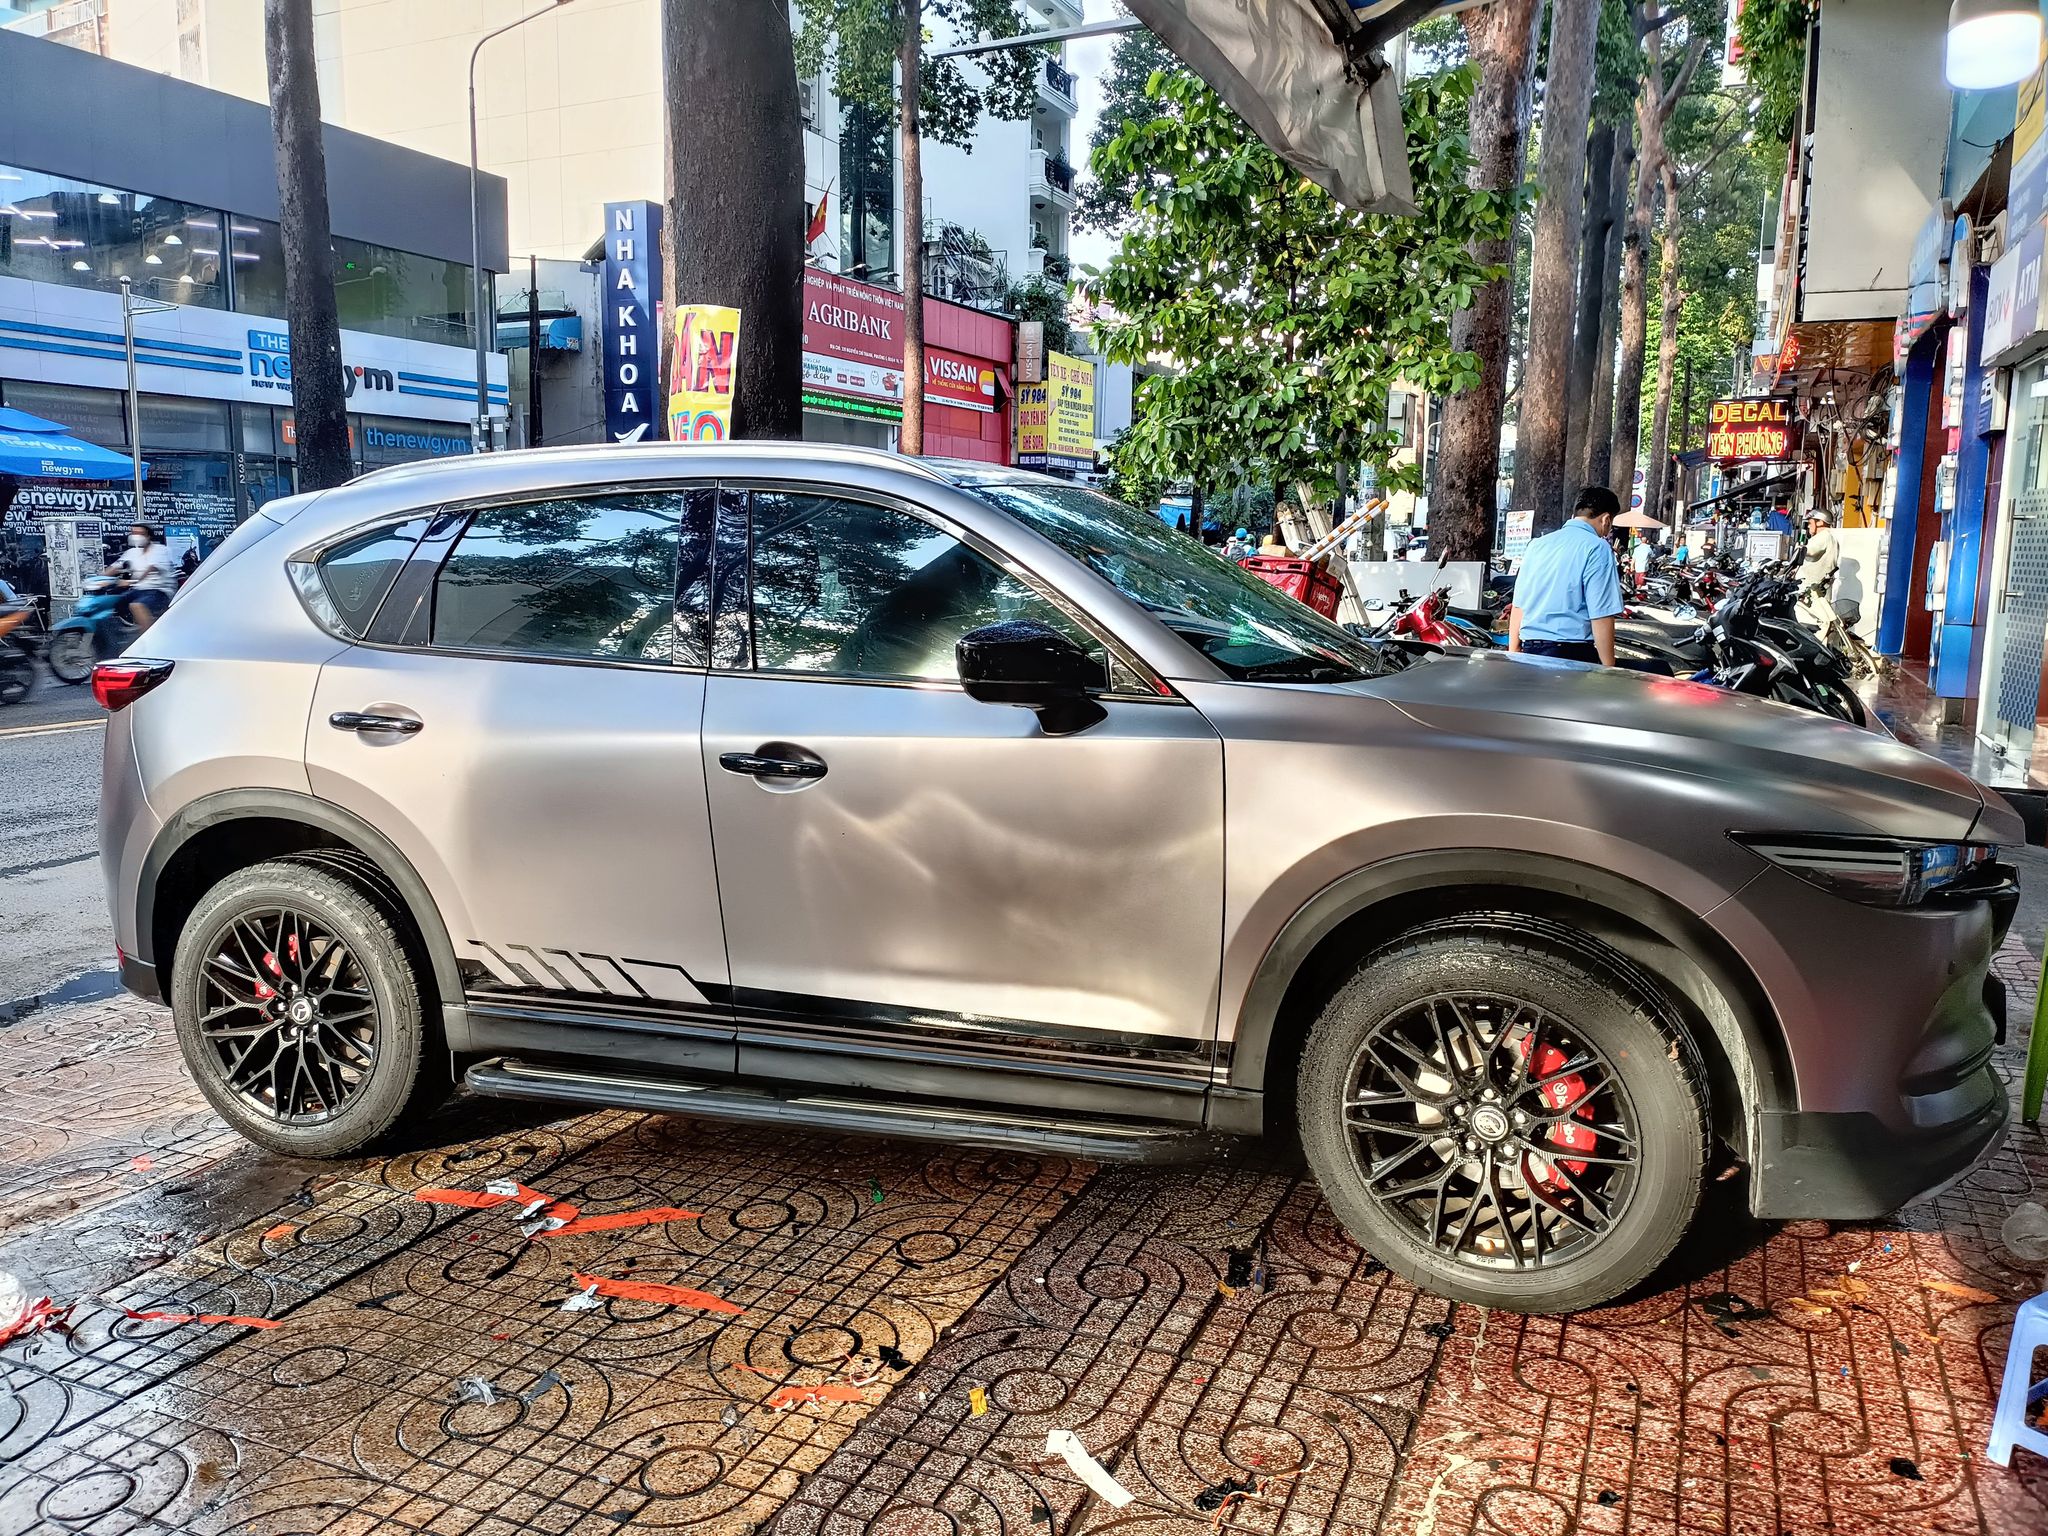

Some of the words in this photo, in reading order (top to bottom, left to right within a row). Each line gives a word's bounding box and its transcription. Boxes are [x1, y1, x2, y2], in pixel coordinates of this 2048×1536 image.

[616, 209, 636, 290] NHA
[2016, 254, 2042, 313] ATM
[807, 300, 892, 340] AGRIBANK
[257, 333, 288, 350] THE
[618, 305, 640, 413] KHOA
[930, 356, 977, 384] VISSAN
[1025, 344, 1033, 379] VISSAN
[1032, 388, 1046, 404] 984
[1070, 387, 1082, 400] 984
[1713, 403, 1787, 423] DECAL
[1711, 422, 1735, 456] YẾN
[42, 466, 84, 475] newgym
[238, 453, 246, 484] 332
[158, 508, 187, 517] gym.vn
[175, 502, 209, 510] thenew
[209, 507, 234, 515] gym.vn
